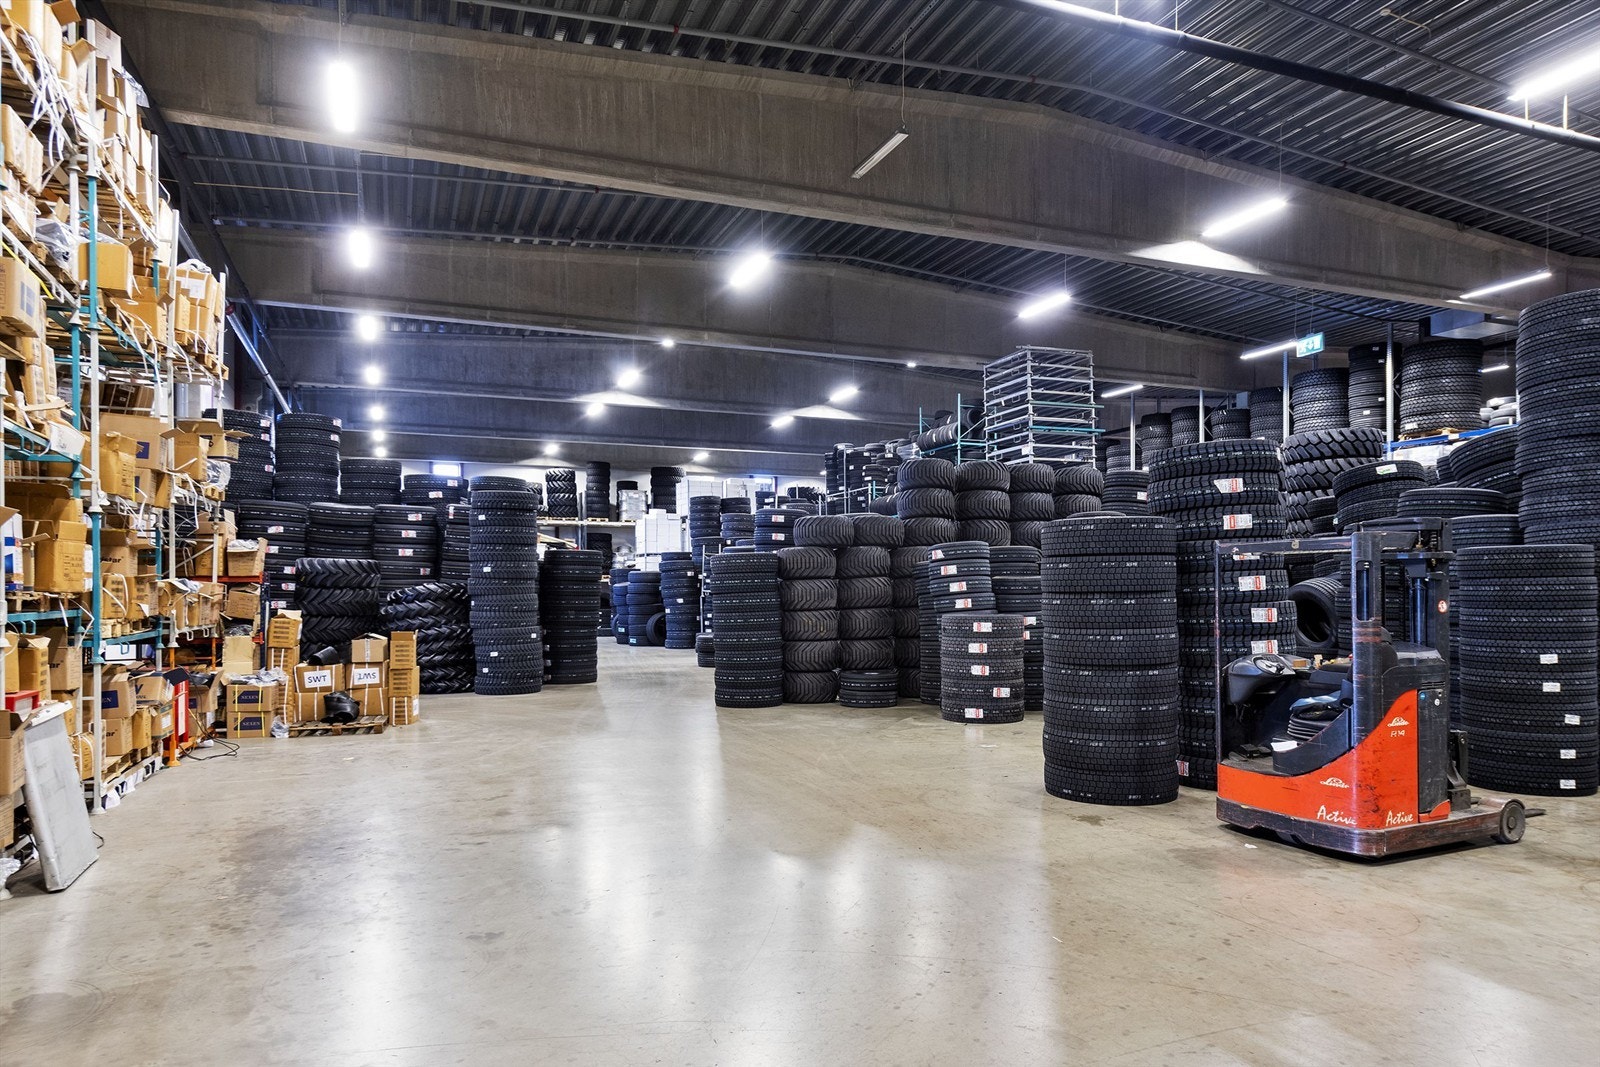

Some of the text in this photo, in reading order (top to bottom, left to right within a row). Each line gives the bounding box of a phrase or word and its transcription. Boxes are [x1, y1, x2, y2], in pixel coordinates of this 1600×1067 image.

[307, 675, 327, 684] SWT
[1316, 804, 1357, 825] Active
[1385, 810, 1414, 827] Active
